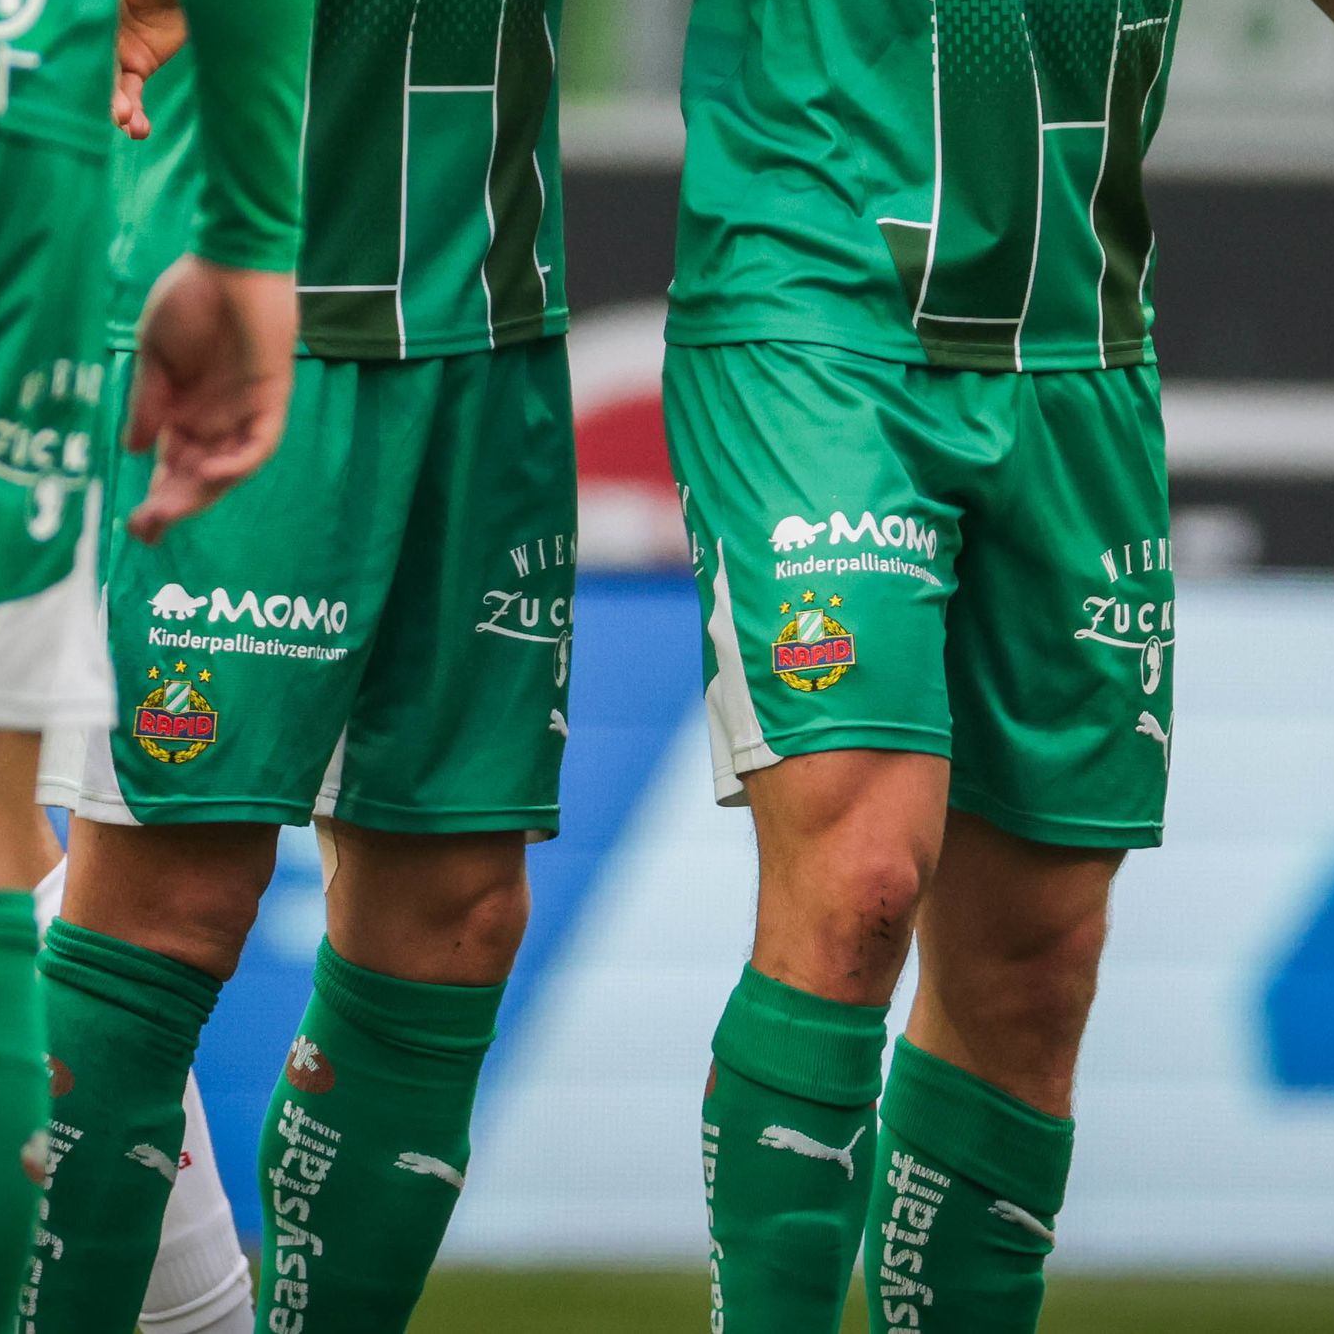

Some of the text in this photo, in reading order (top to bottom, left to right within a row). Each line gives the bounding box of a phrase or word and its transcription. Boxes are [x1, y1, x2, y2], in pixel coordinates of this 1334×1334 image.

[207, 586, 349, 635] MOMO
[147, 626, 349, 661] Kinderpalliativzentrum
[776, 638, 853, 667] RAPID
[139, 709, 214, 738] RAPID
[268, 1099, 343, 1334] easystaff
